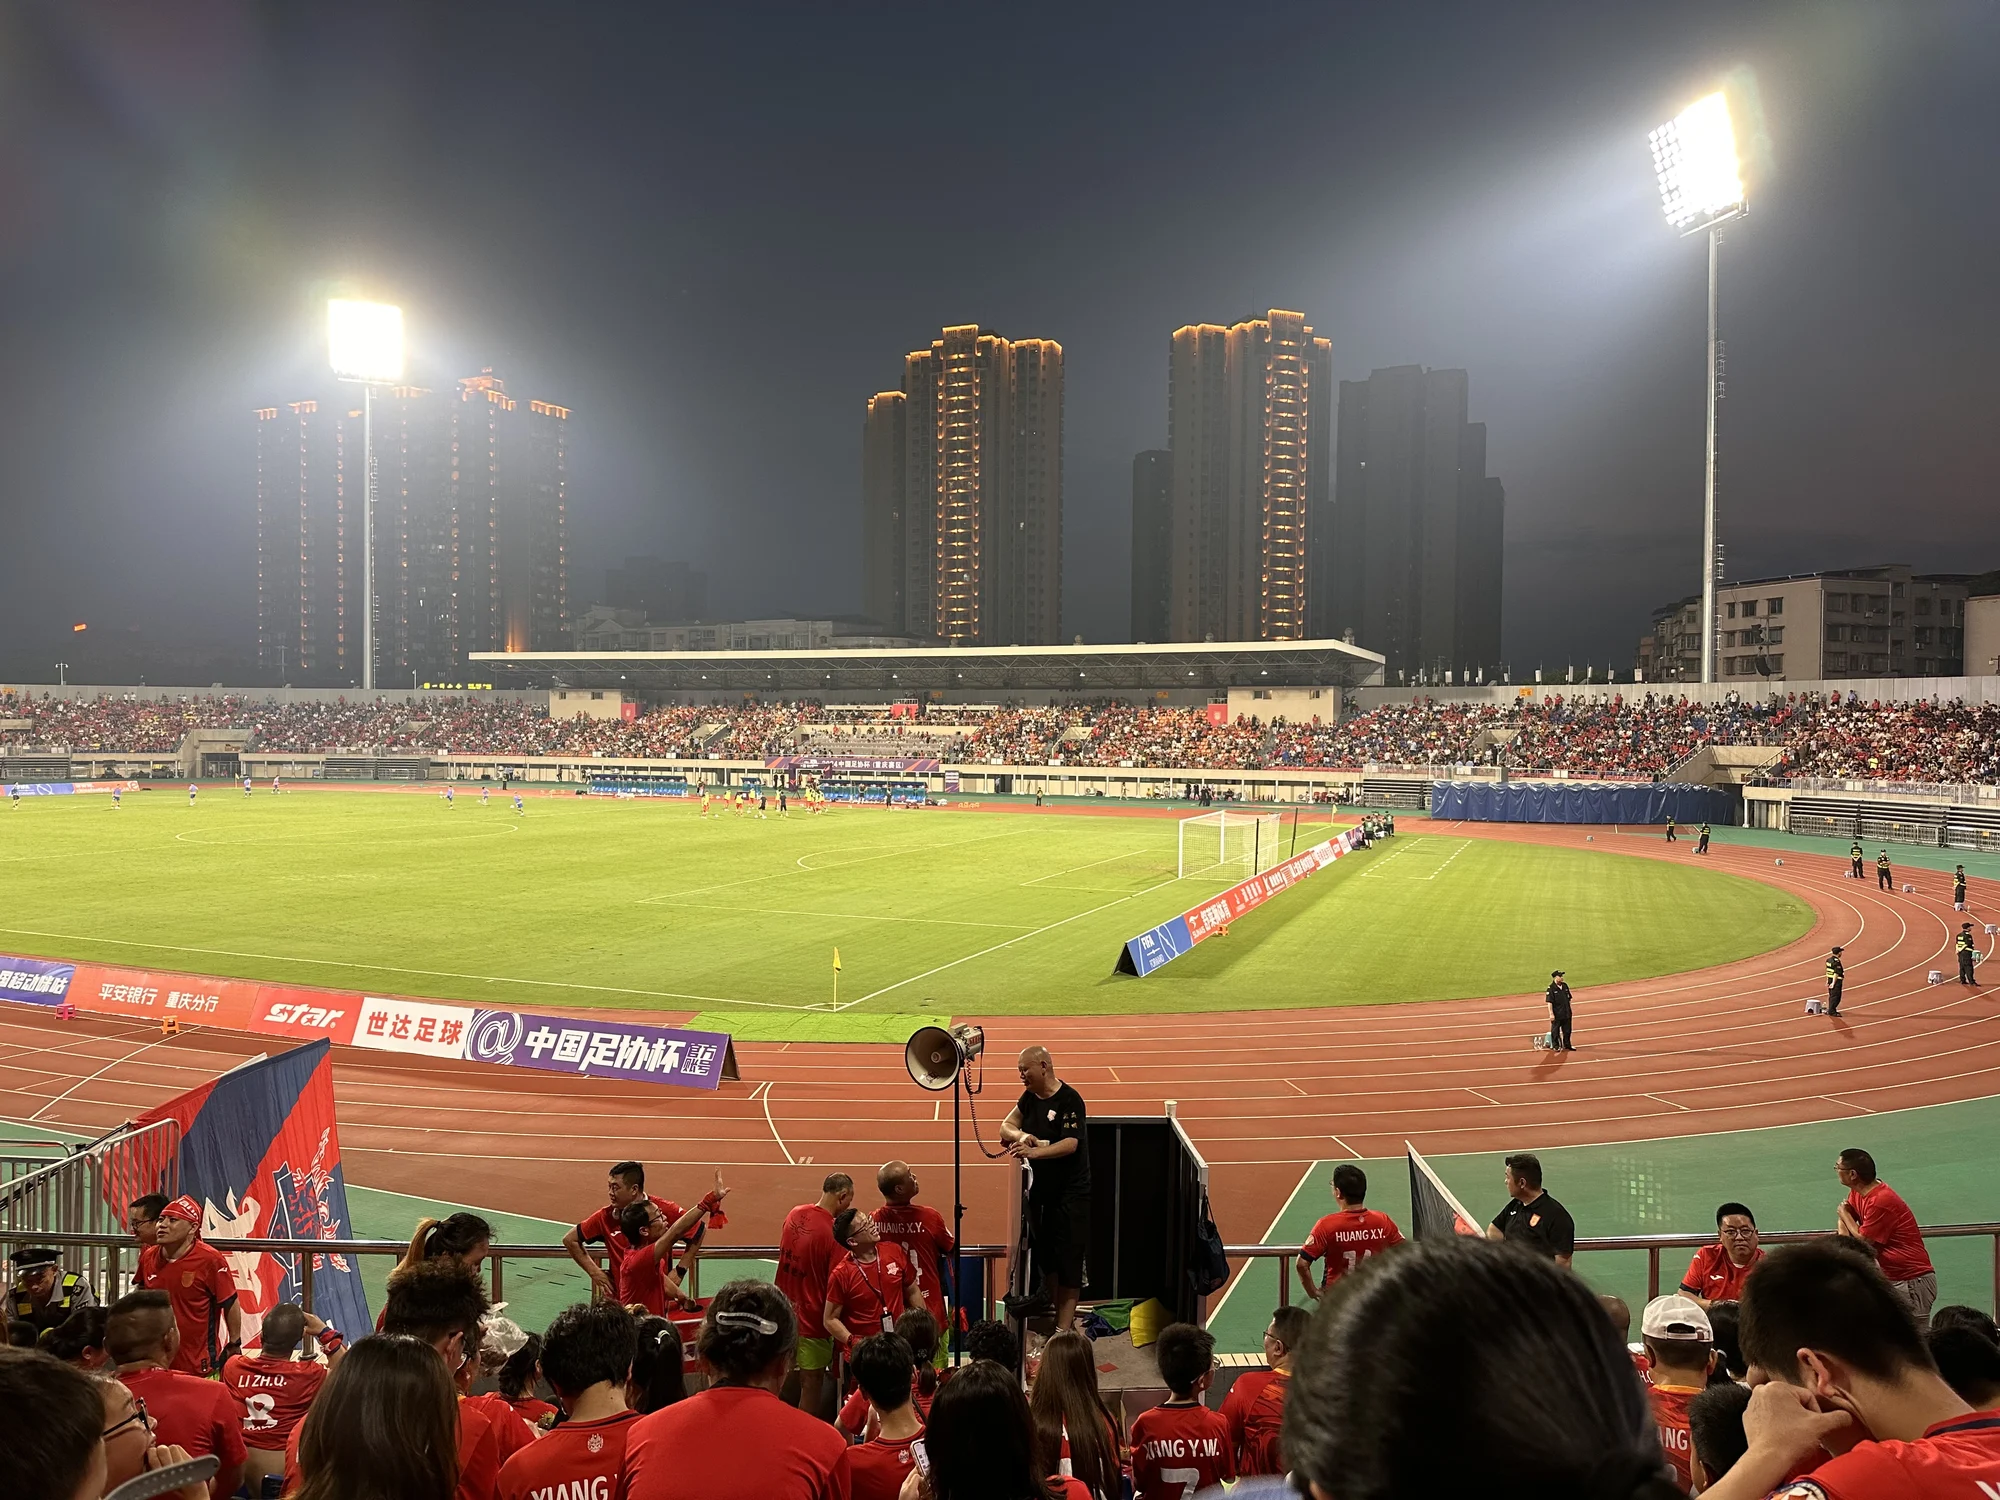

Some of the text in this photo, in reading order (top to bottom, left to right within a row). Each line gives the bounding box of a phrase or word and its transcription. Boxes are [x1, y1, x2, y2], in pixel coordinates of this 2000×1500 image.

[1141, 934, 1155, 950] FIFA
[98, 983, 219, 1012] 平安银行 重庆分行
[366, 1011, 463, 1045] 世达足球
[906, 1221, 925, 1233] X.Y.
[1335, 1228, 1386, 1242] HUANG X.Y.
[238, 1374, 288, 1388] LI ZH.Q.
[1187, 1438, 1220, 1458] Y.W.
[1160, 1467, 1200, 1500] 7
